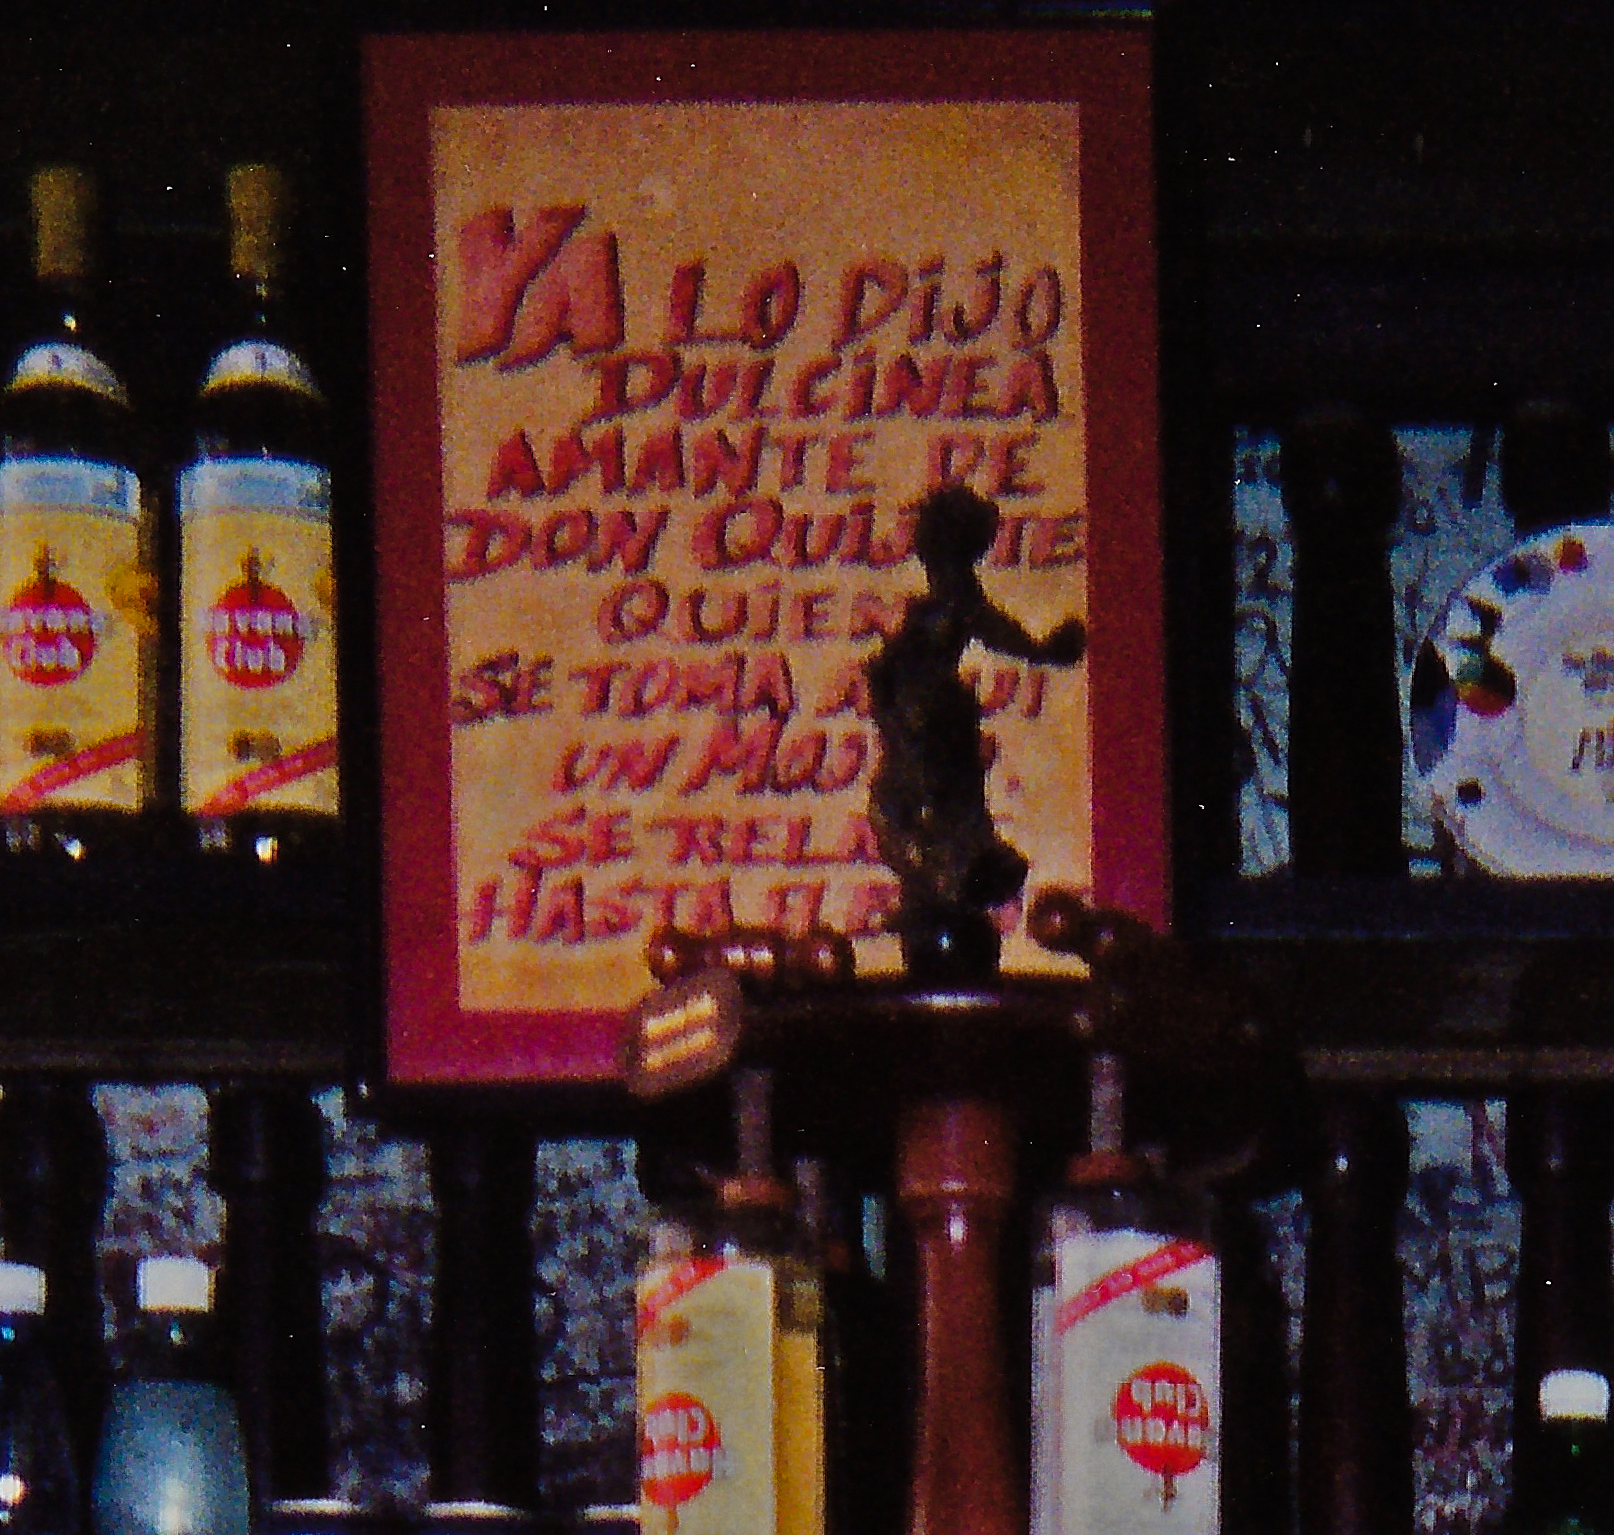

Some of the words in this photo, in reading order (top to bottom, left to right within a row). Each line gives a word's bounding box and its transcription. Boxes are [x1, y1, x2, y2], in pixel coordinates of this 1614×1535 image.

[664, 258, 803, 348] LO
[485, 425, 878, 506] AMANTE
[926, 430, 1047, 498] DE
[441, 506, 672, 586] DON
[690, 496, 1088, 572] QUIJTE
[450, 650, 556, 724] SE
[817, 660, 1048, 720] AUI
[552, 732, 678, 794] UN
[510, 806, 636, 874] SE
